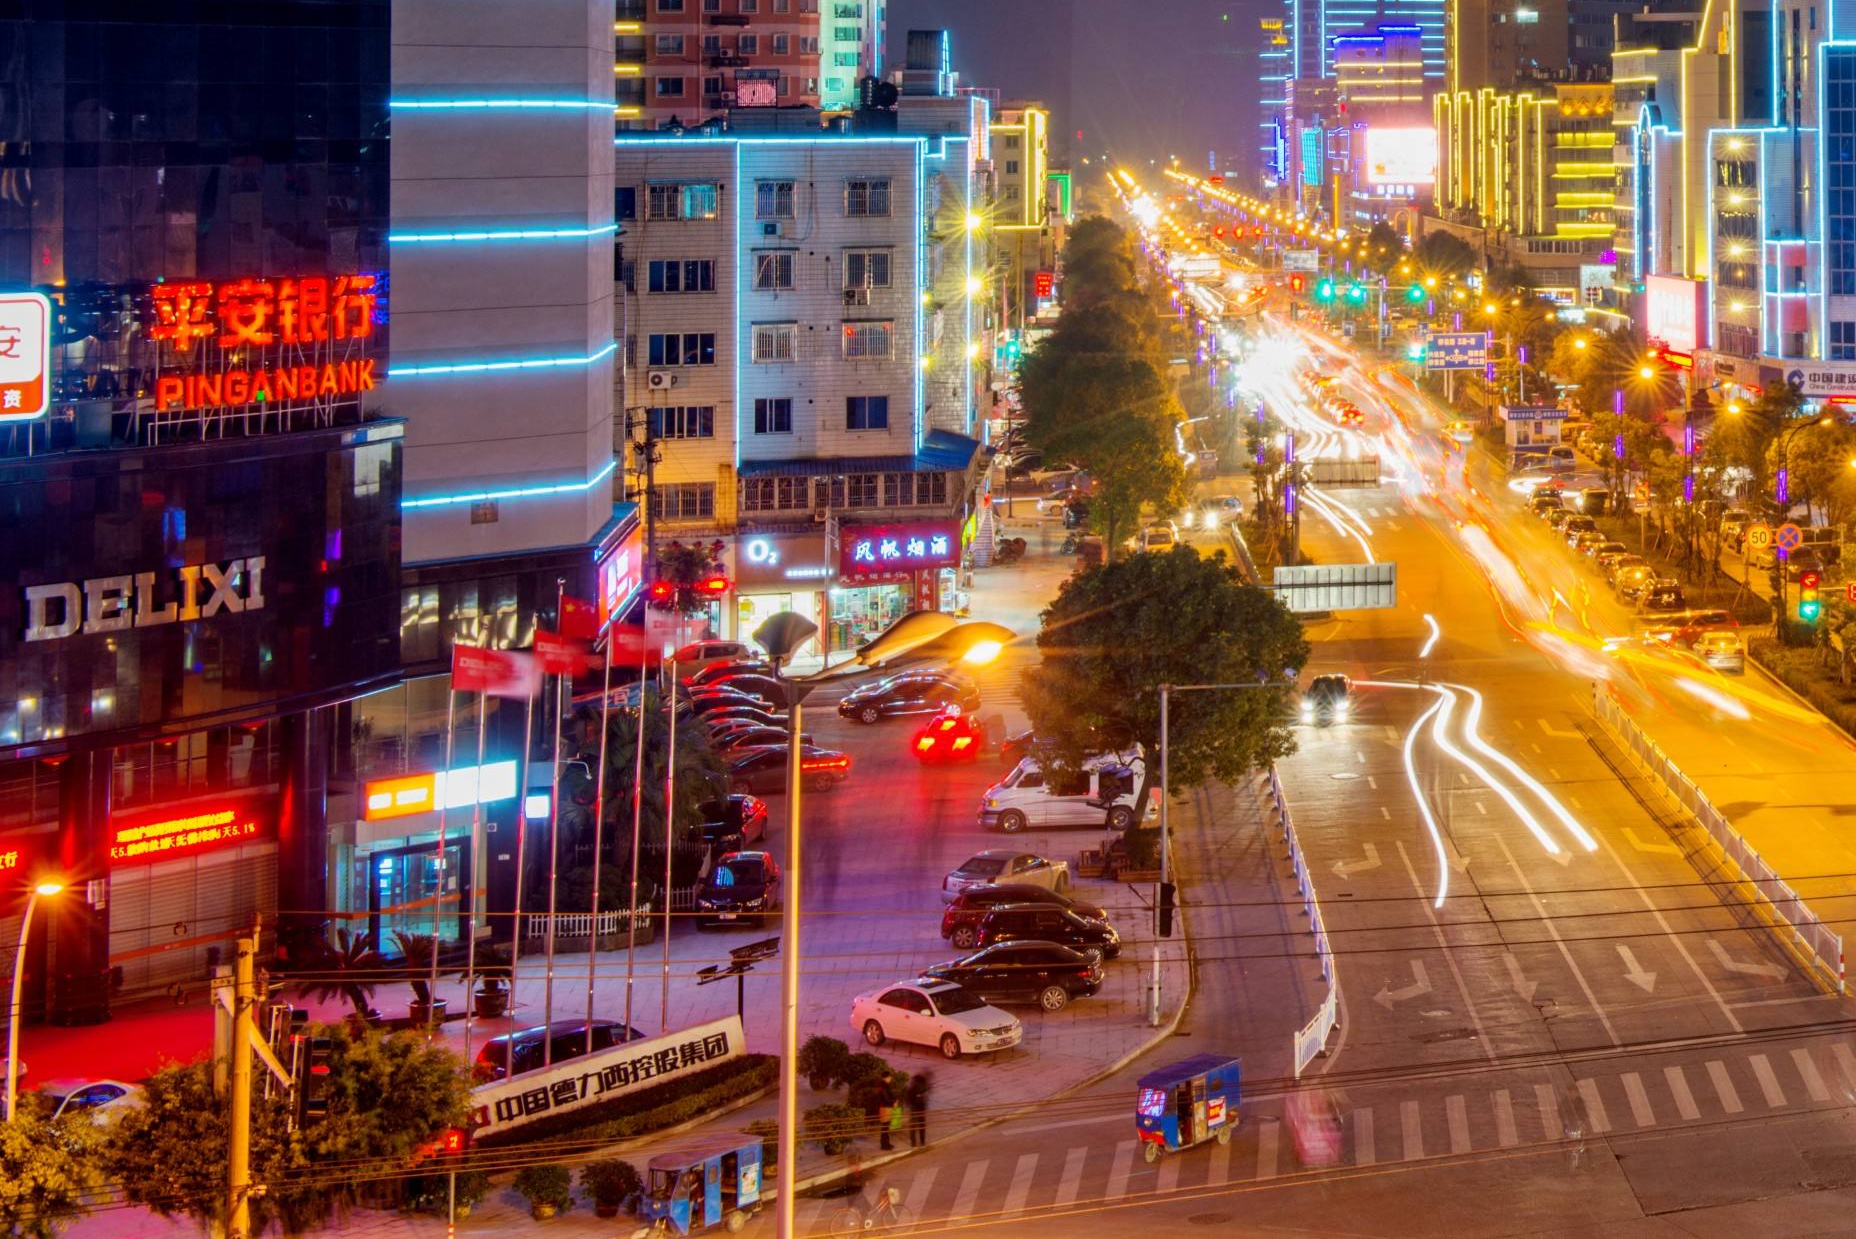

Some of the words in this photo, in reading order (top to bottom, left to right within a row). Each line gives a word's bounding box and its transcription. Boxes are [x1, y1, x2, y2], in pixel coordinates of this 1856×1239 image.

[150, 275, 376, 352] 平安银行
[854, 535, 948, 561] 风帆烟酒
[1751, 531, 1767, 544] 50
[25, 555, 266, 642] DELIXI
[495, 1031, 730, 1122] 中国德力西控股集团
